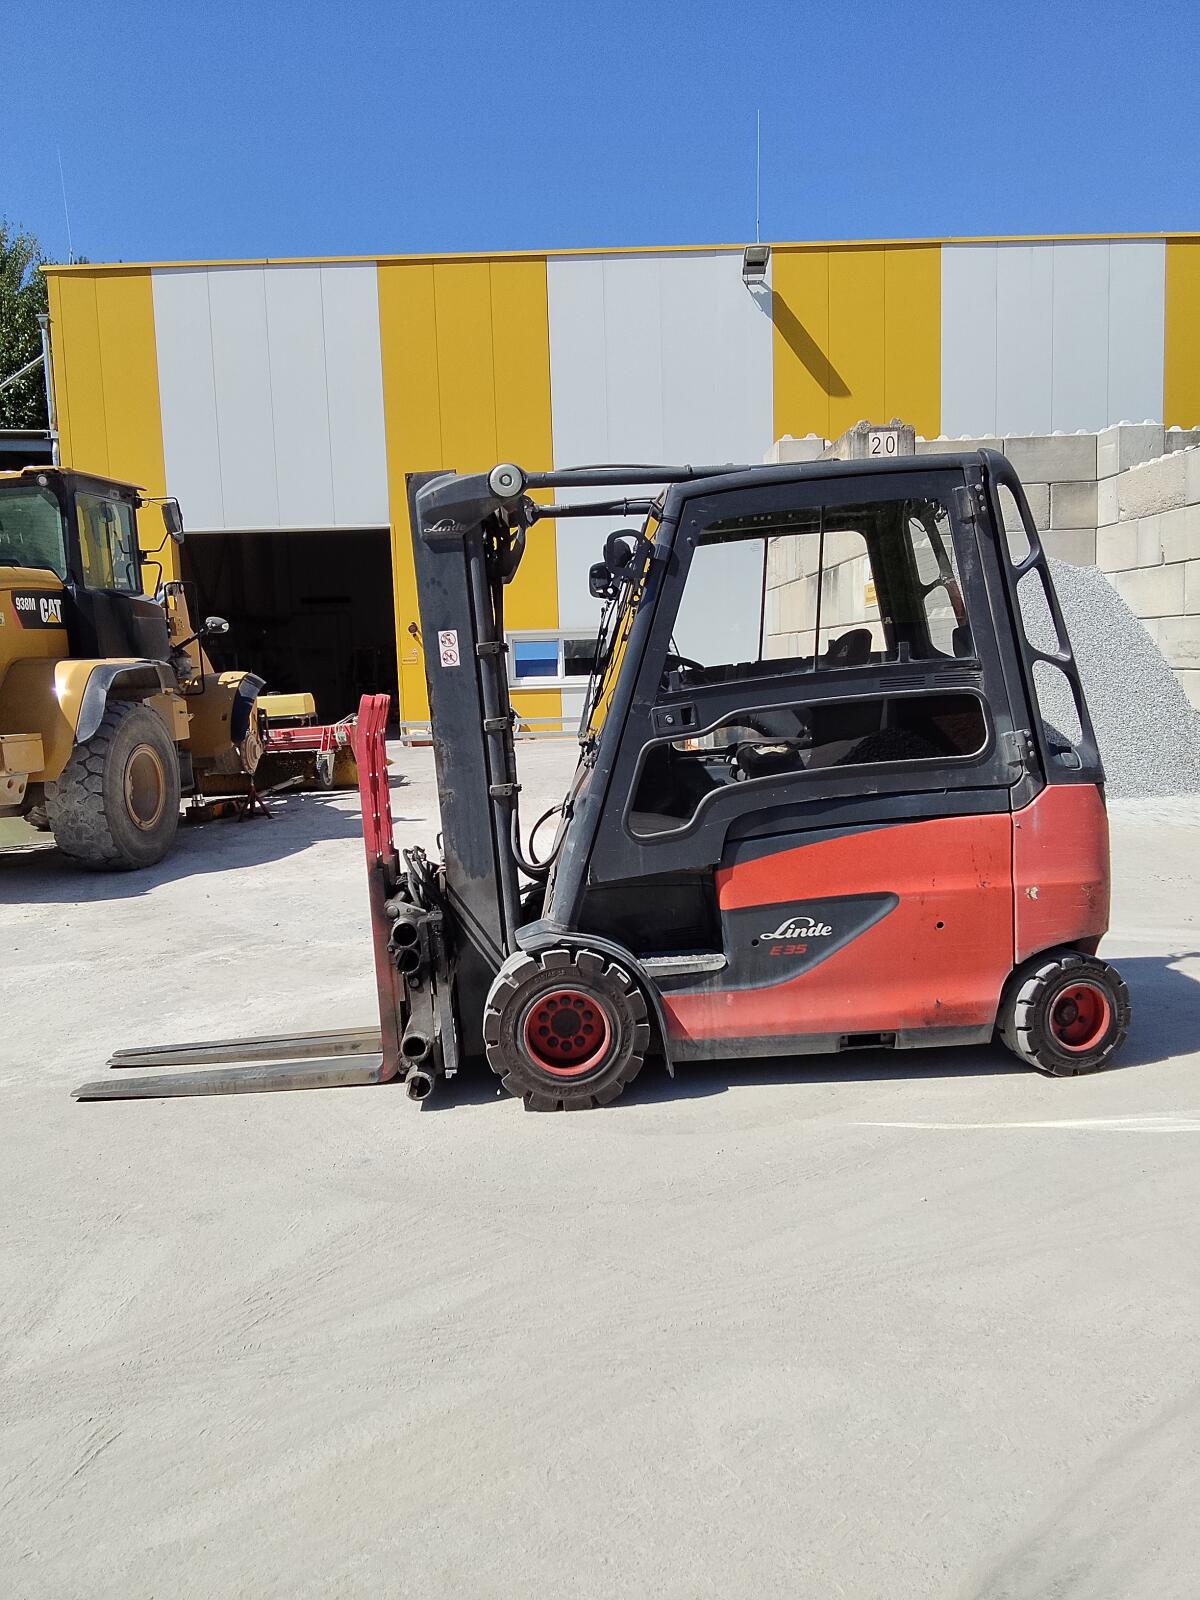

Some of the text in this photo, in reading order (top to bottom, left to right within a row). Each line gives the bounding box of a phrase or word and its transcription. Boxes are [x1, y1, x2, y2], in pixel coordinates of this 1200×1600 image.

[871, 435, 895, 455] 20
[15, 597, 62, 623] 938M CAT
[759, 916, 832, 940] Linde
[769, 943, 808, 956] E 35
